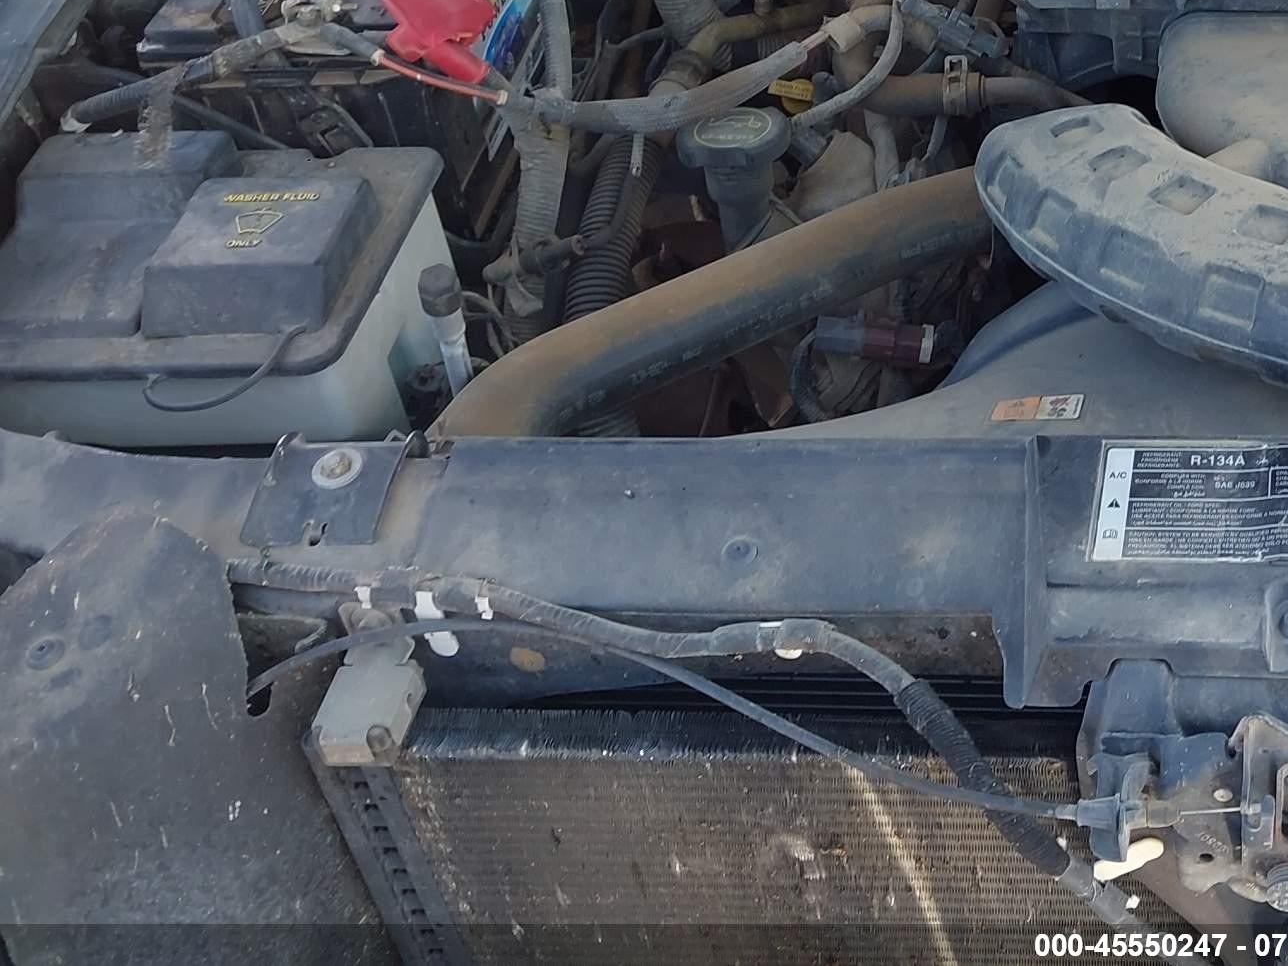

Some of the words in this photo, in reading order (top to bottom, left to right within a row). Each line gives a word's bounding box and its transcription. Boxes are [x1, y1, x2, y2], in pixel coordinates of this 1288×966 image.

[223, 193, 280, 203] WASHER
[282, 193, 320, 201] FLUID
[225, 239, 262, 248] ONLY
[1190, 453, 1246, 467] R-134A
[1109, 471, 1127, 480] A/C
